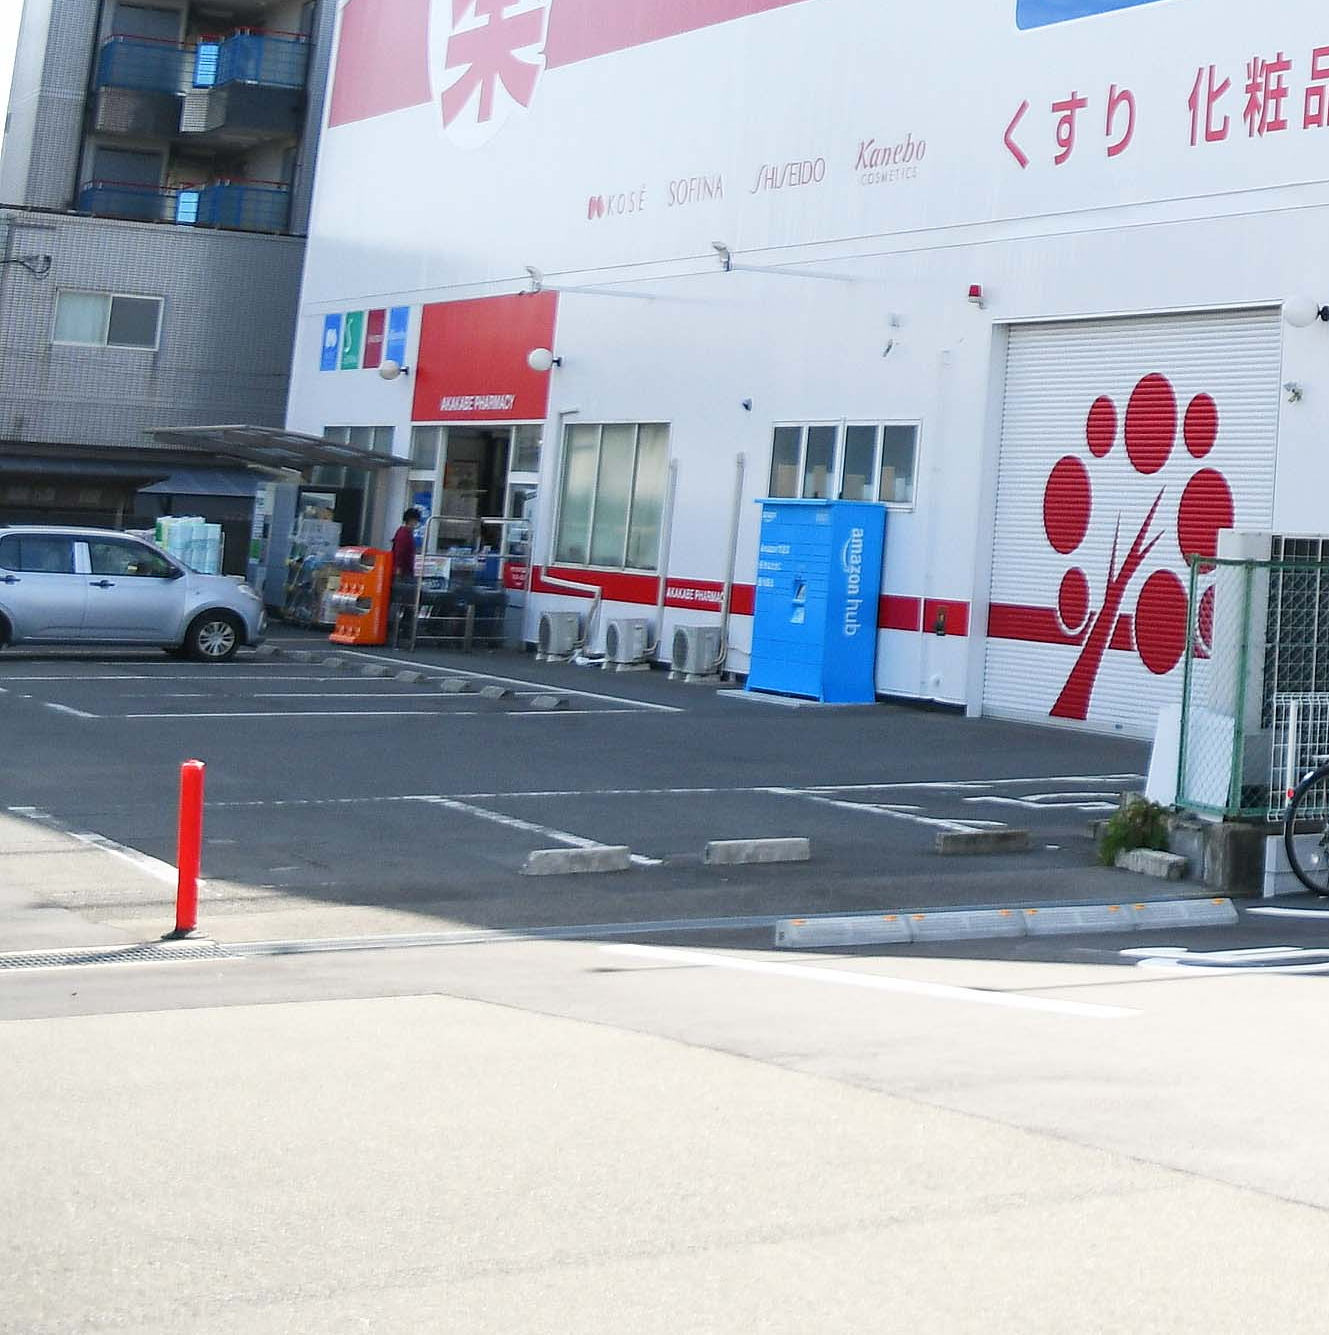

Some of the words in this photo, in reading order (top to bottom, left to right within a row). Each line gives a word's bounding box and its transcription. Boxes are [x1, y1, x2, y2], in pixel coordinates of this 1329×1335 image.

[1001, 84, 1137, 169] くすり
[854, 132, 927, 171] Kanebo
[667, 175, 724, 207] SOFINA
[750, 156, 826, 195] SHISEIDO
[848, 527, 864, 595] amazon
[695, 588, 727, 603] PHARMAC
[845, 599, 863, 636] hub
